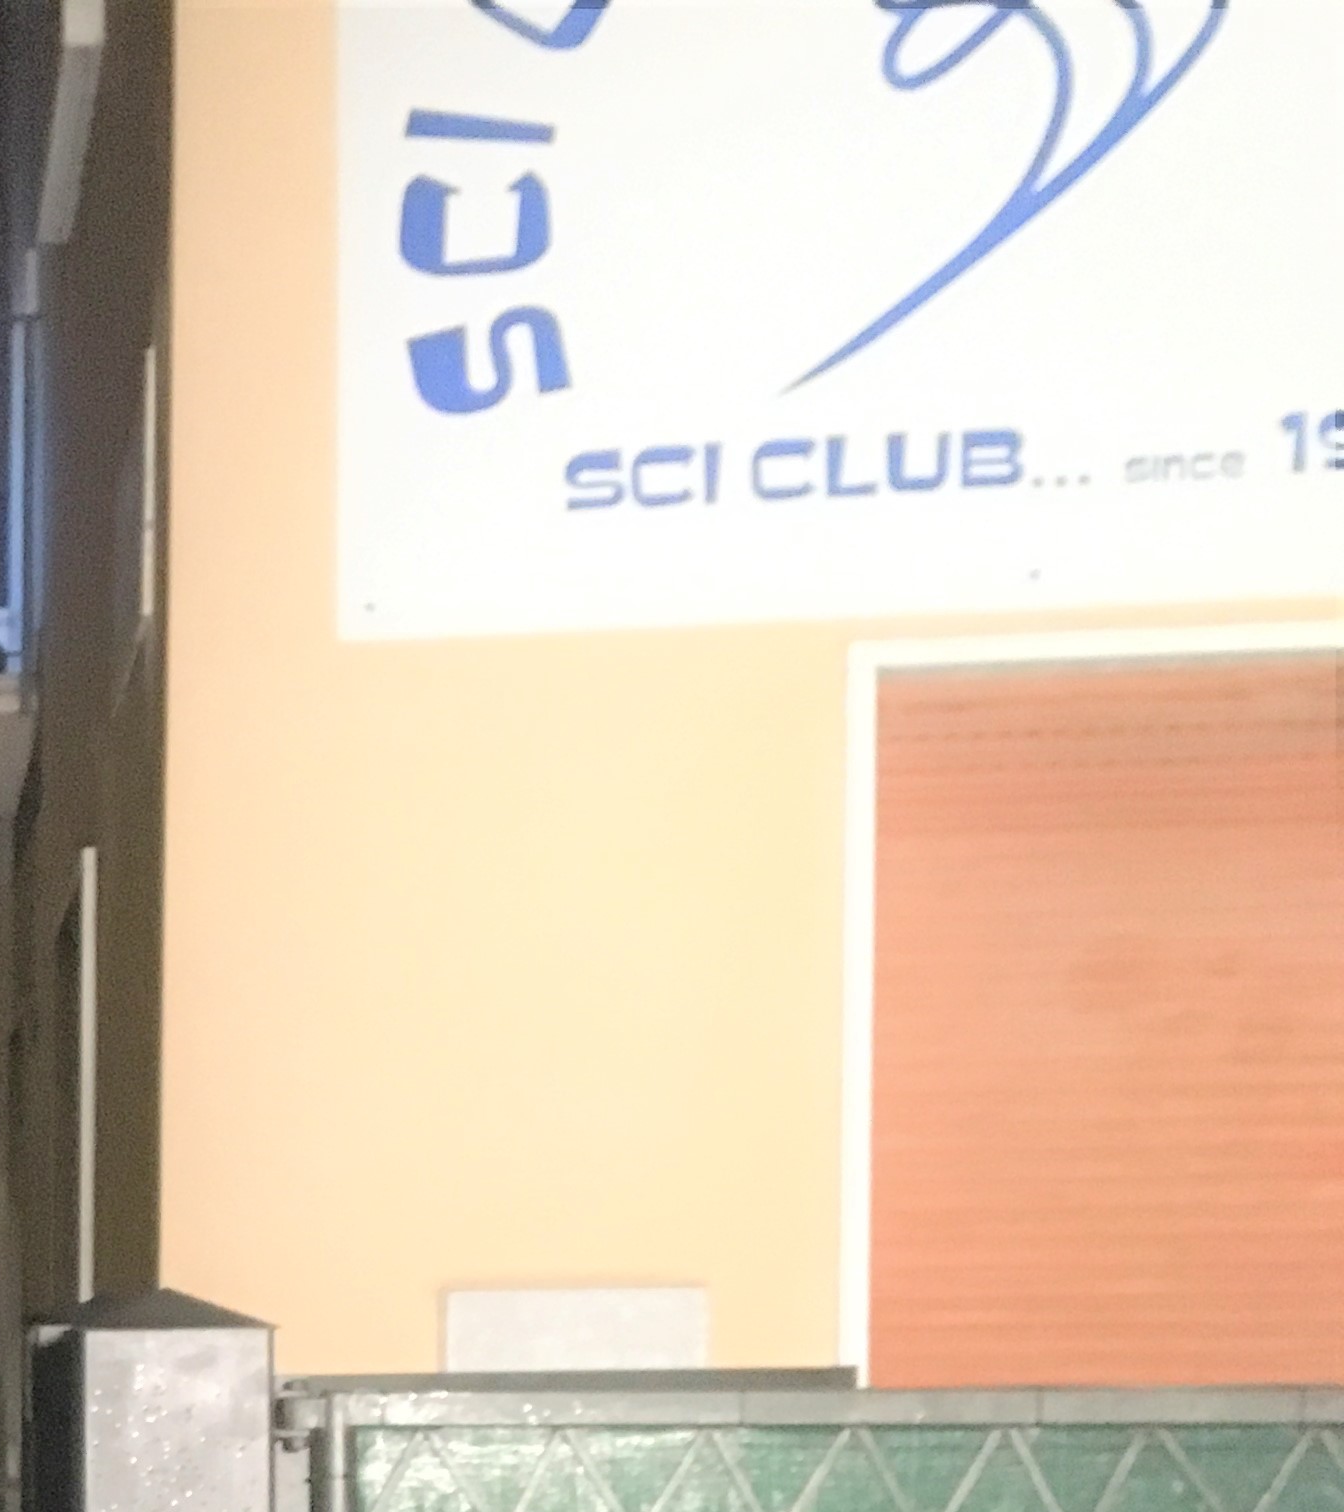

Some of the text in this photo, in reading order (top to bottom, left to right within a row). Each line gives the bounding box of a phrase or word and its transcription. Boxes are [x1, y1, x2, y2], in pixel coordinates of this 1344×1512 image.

[399, 107, 572, 415] SCI
[564, 442, 722, 511] SCI
[1124, 448, 1246, 484] since
